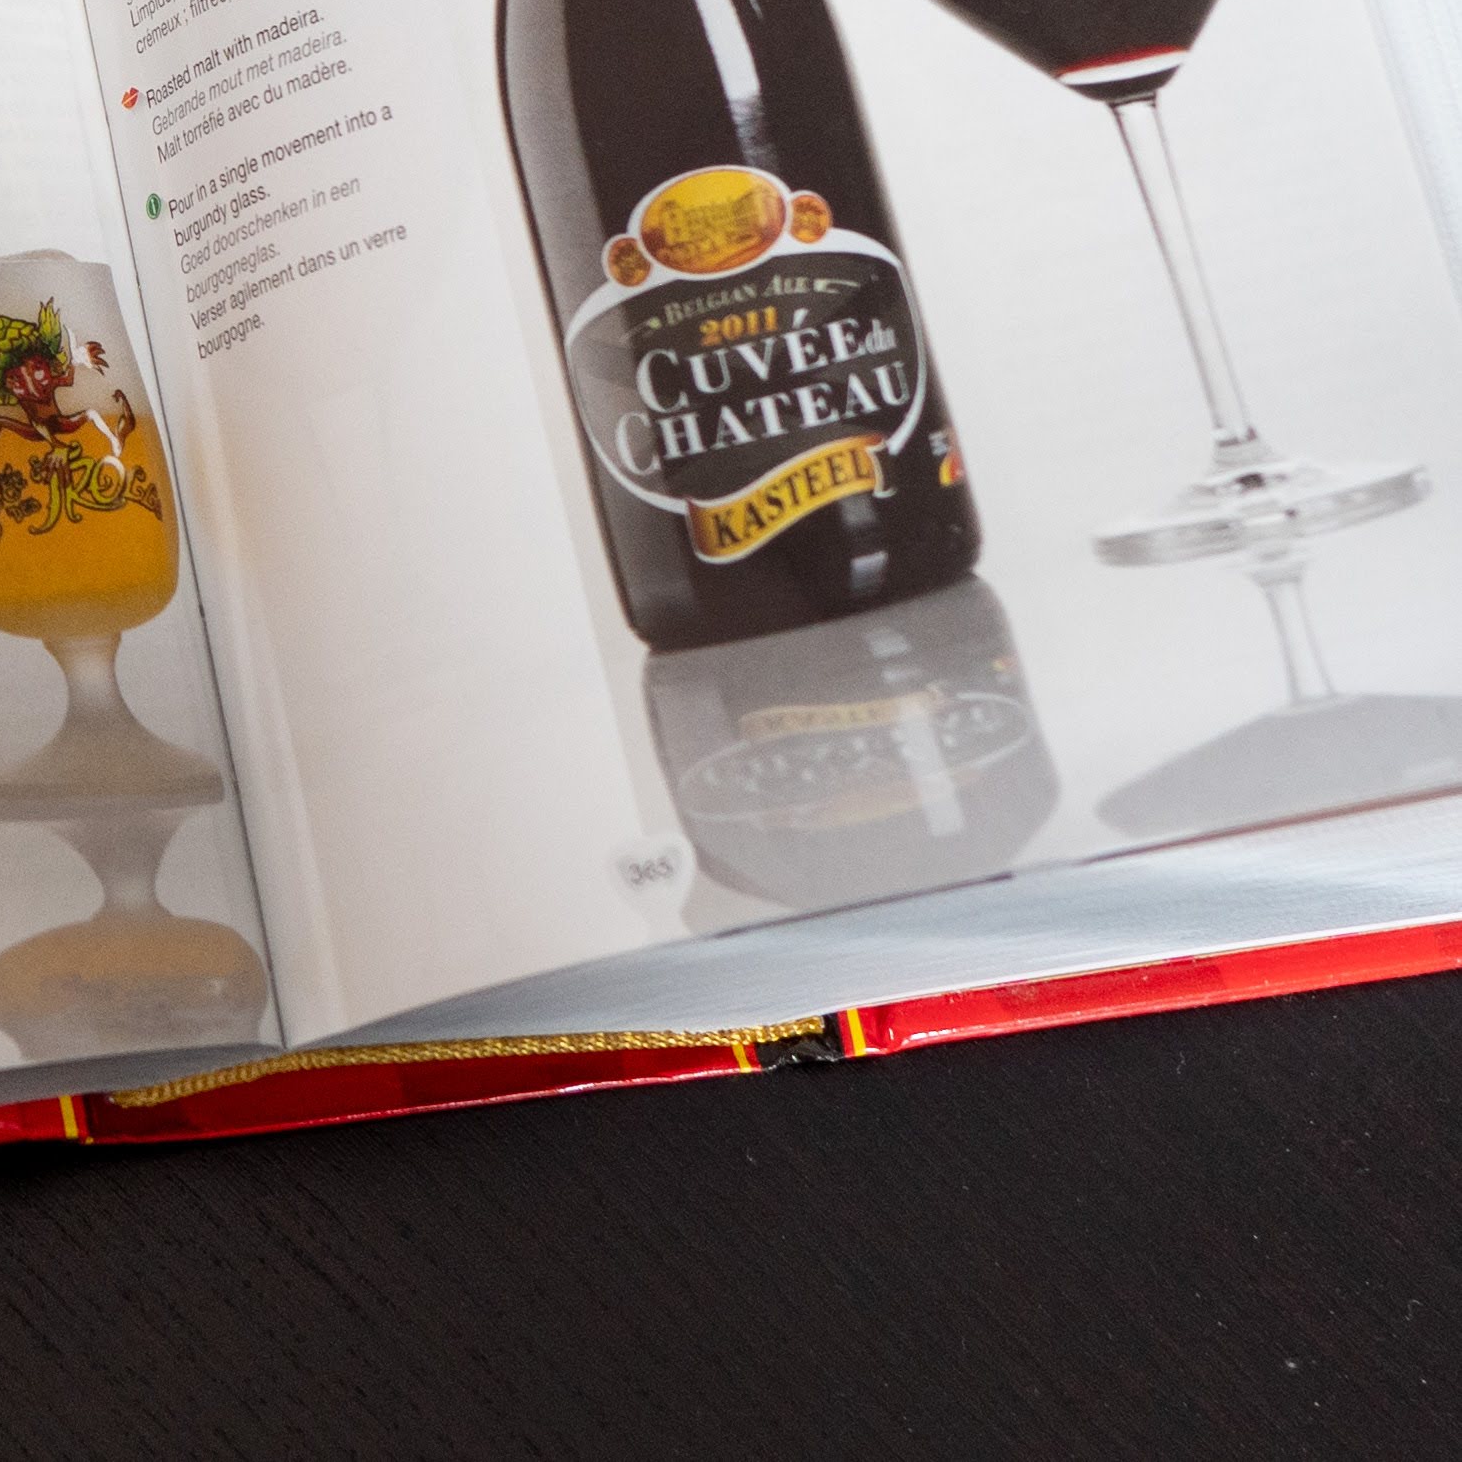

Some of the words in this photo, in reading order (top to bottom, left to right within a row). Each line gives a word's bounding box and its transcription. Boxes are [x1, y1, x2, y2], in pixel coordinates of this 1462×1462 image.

[145, 65, 192, 109] Roasted
[193, 49, 221, 77] malt
[223, 35, 253, 61] with
[256, 9, 324, 45] madeira.
[167, 192, 194, 220] Pour
[196, 184, 207, 201] in
[209, 179, 218, 194] a
[219, 157, 258, 188] single
[261, 120, 342, 167] movement
[345, 111, 377, 133] into
[381, 105, 393, 121] a
[174, 205, 226, 247] burgundy
[230, 186, 270, 218] glass.
[699, 305, 779, 347] 2011
[615, 360, 911, 476] CHATEAU
[712, 447, 872, 549] KASTEEL
